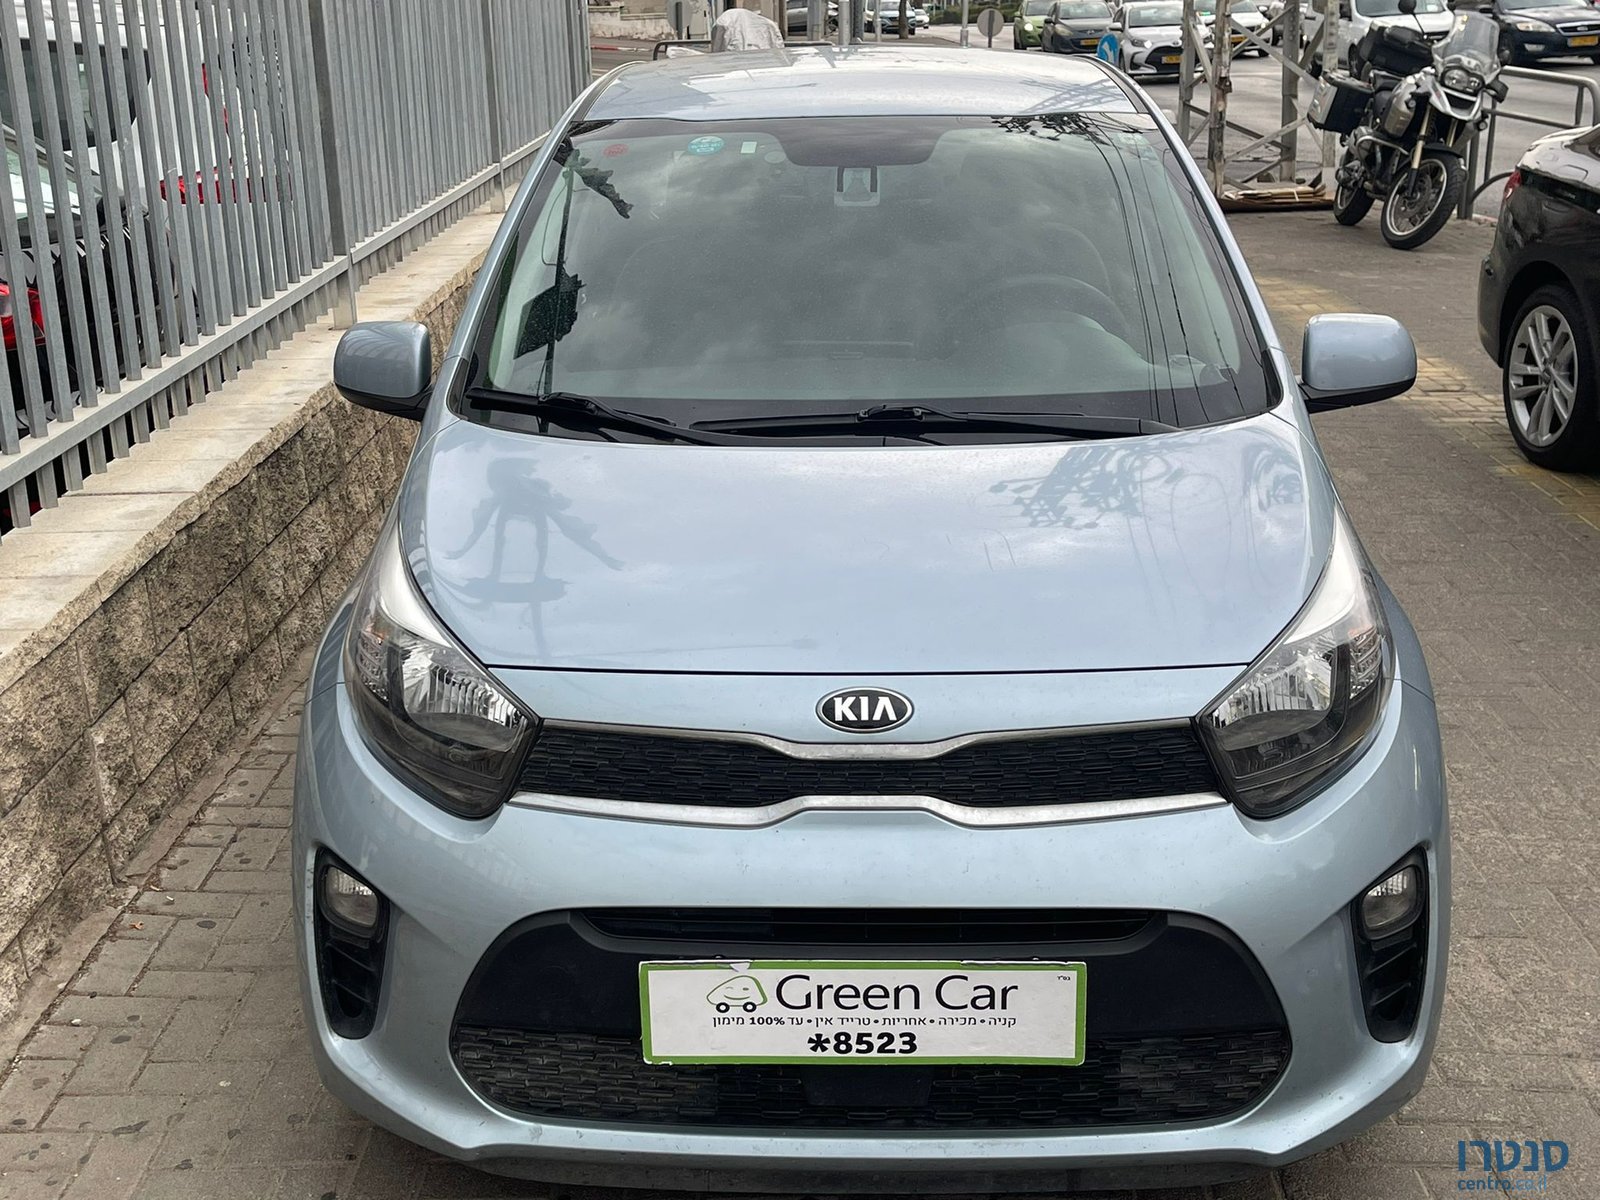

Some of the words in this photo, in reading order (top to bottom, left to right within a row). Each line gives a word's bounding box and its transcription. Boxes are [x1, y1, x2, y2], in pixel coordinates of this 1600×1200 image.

[833, 696, 897, 721] KIA
[775, 974, 920, 1011] Green
[935, 974, 1019, 1011] Car
[712, 1017, 745, 1028] מימון
[749, 1016, 786, 1026] 100%
[787, 1017, 804, 1026] עד
[815, 1017, 833, 1028] אין
[837, 1017, 871, 1026] טרייד
[881, 1017, 927, 1026] אחריות
[938, 1017, 977, 1026] מכירה
[988, 1017, 1017, 1028] קניה
